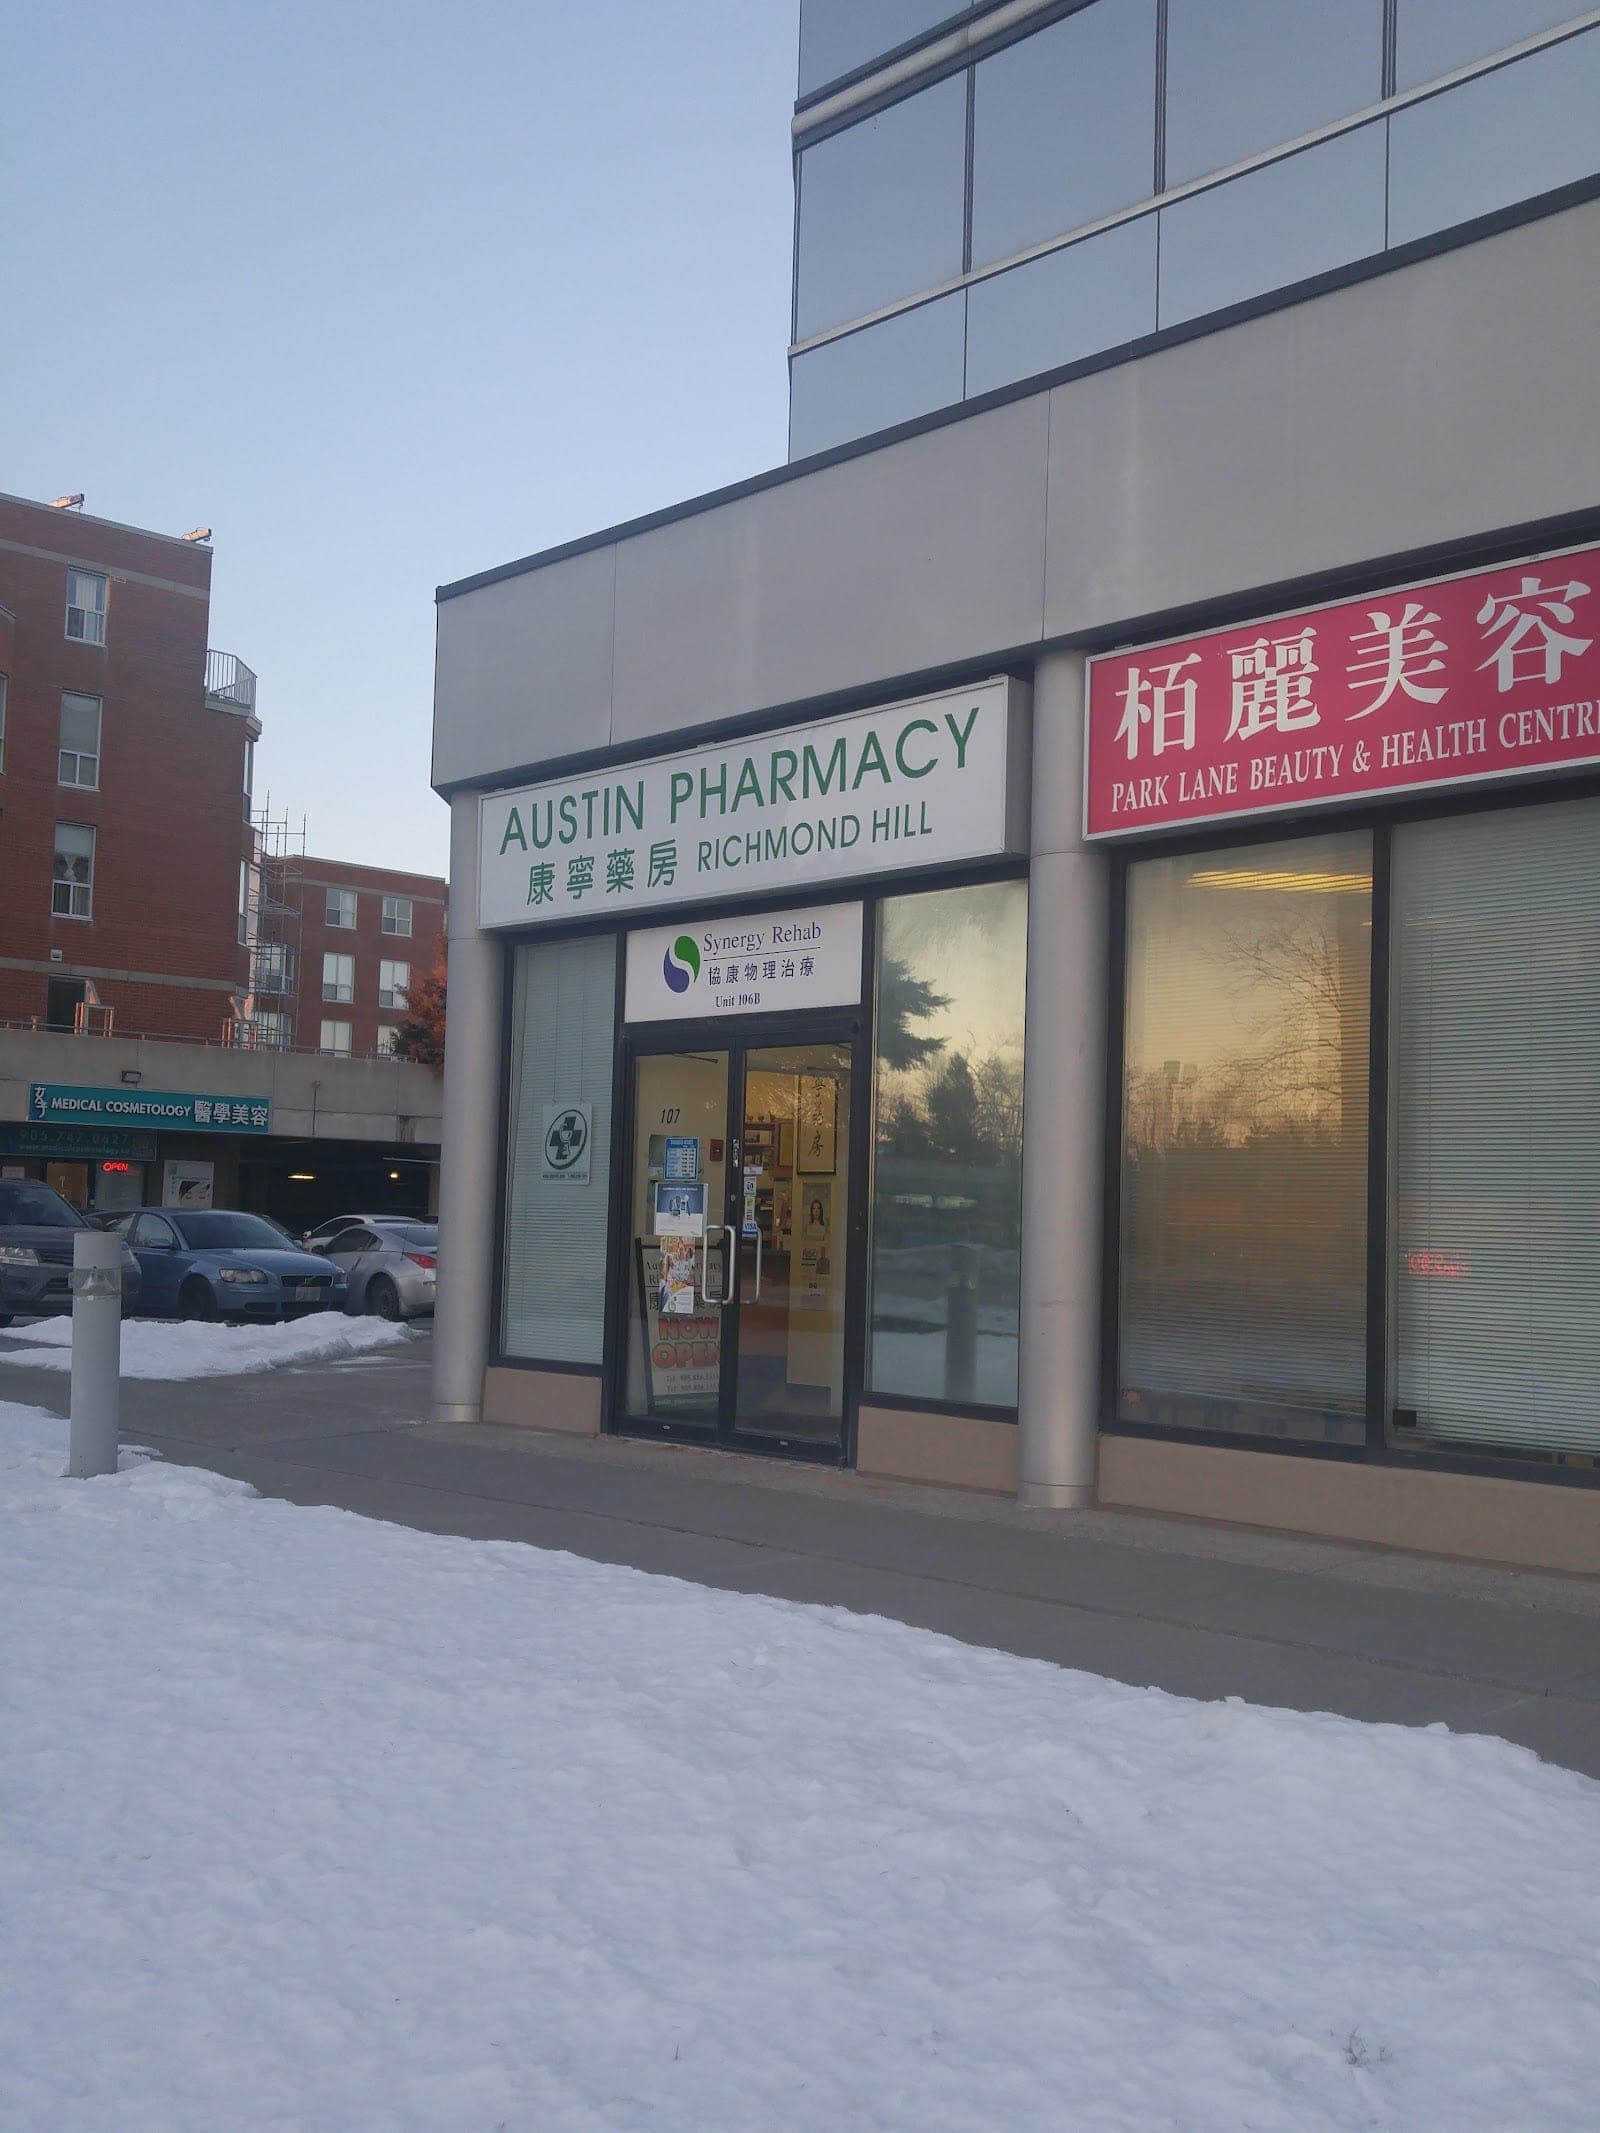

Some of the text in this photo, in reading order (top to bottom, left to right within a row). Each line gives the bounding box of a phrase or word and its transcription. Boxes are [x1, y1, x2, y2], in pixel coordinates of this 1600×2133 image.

[1114, 577, 1594, 761] 柏麗美容
[500, 707, 980, 855] AUSTIN PHARMACY
[1112, 774, 1170, 814] PARK
[1178, 762, 1239, 803] LANE
[1250, 743, 1345, 791] BEAUTY
[1353, 740, 1371, 774] &
[1381, 718, 1487, 769] HEALTH
[698, 801, 933, 873] RICHMOND HILL
[526, 839, 678, 906] 康寧藥房
[703, 921, 821, 955] Synergy Rehab
[708, 955, 816, 986] 協康物理治療
[715, 992, 761, 1008] Unit 106B
[51, 1097, 191, 1117] MEDICAL COSMETOLOGY
[194, 1100, 268, 1126] 醫學美容
[661, 1108, 681, 1124] 107
[102, 1162, 129, 1172] OPEN
[658, 1317, 719, 1340] NOW
